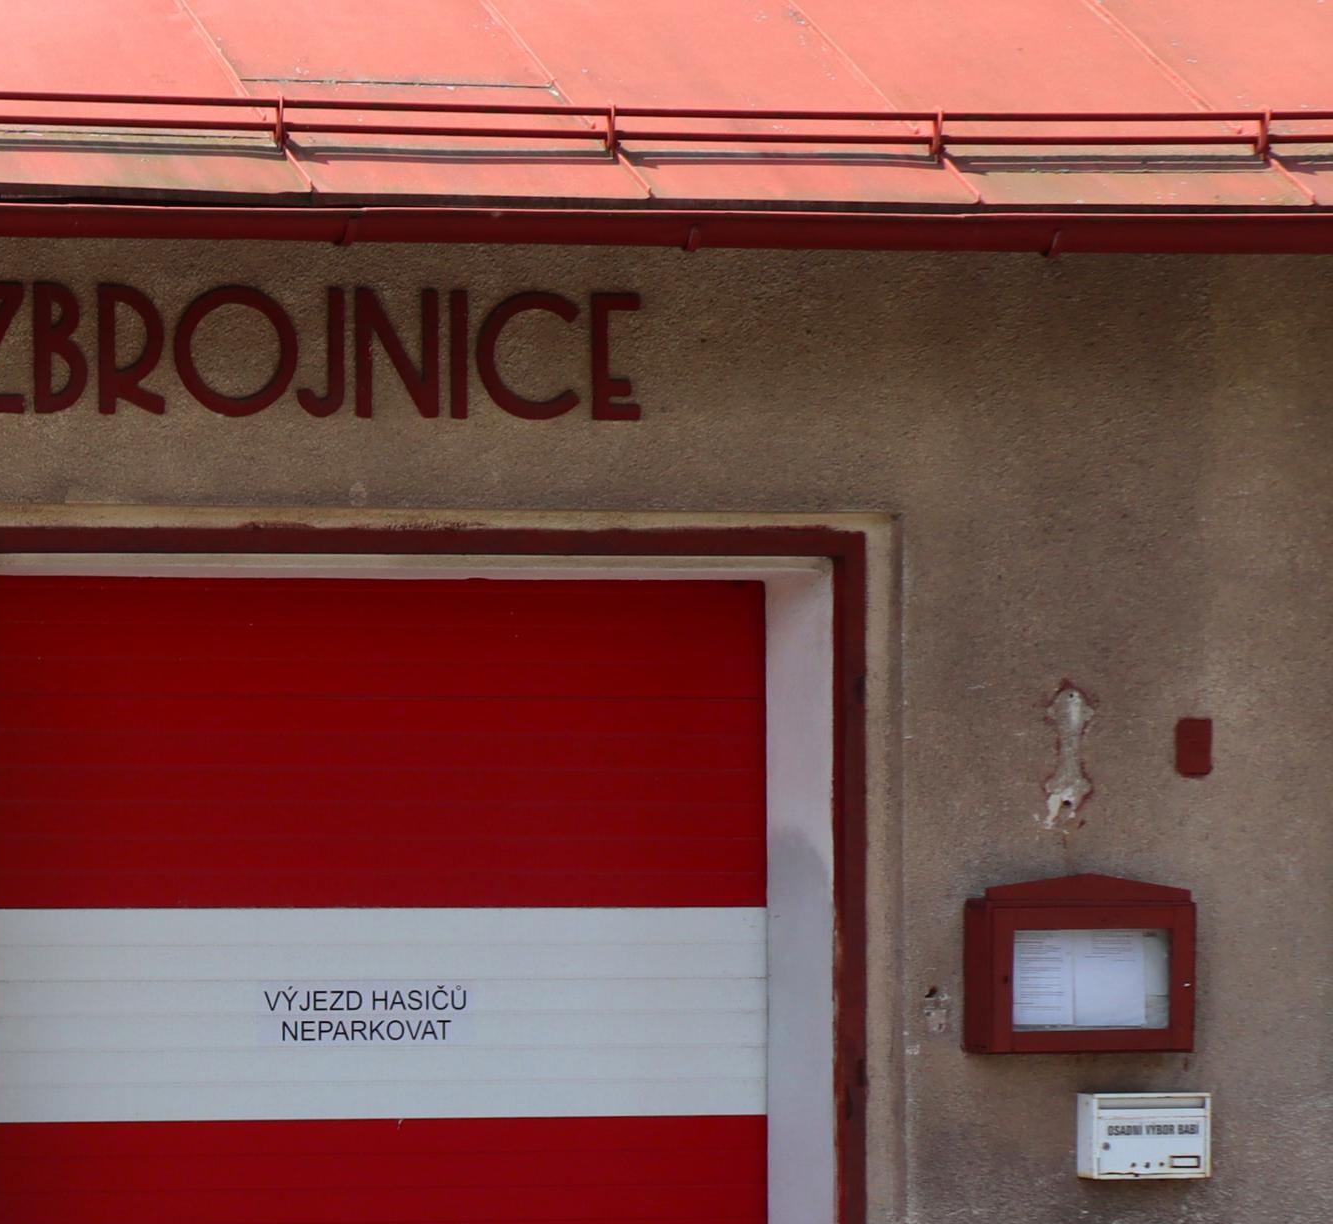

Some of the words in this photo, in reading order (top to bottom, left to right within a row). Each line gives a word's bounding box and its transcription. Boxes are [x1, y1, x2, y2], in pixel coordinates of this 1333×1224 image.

[264, 985, 363, 1012] VÝJEZD
[372, 985, 467, 1011] HASIČŮ
[281, 1019, 452, 1042] NEPARKOVAT
